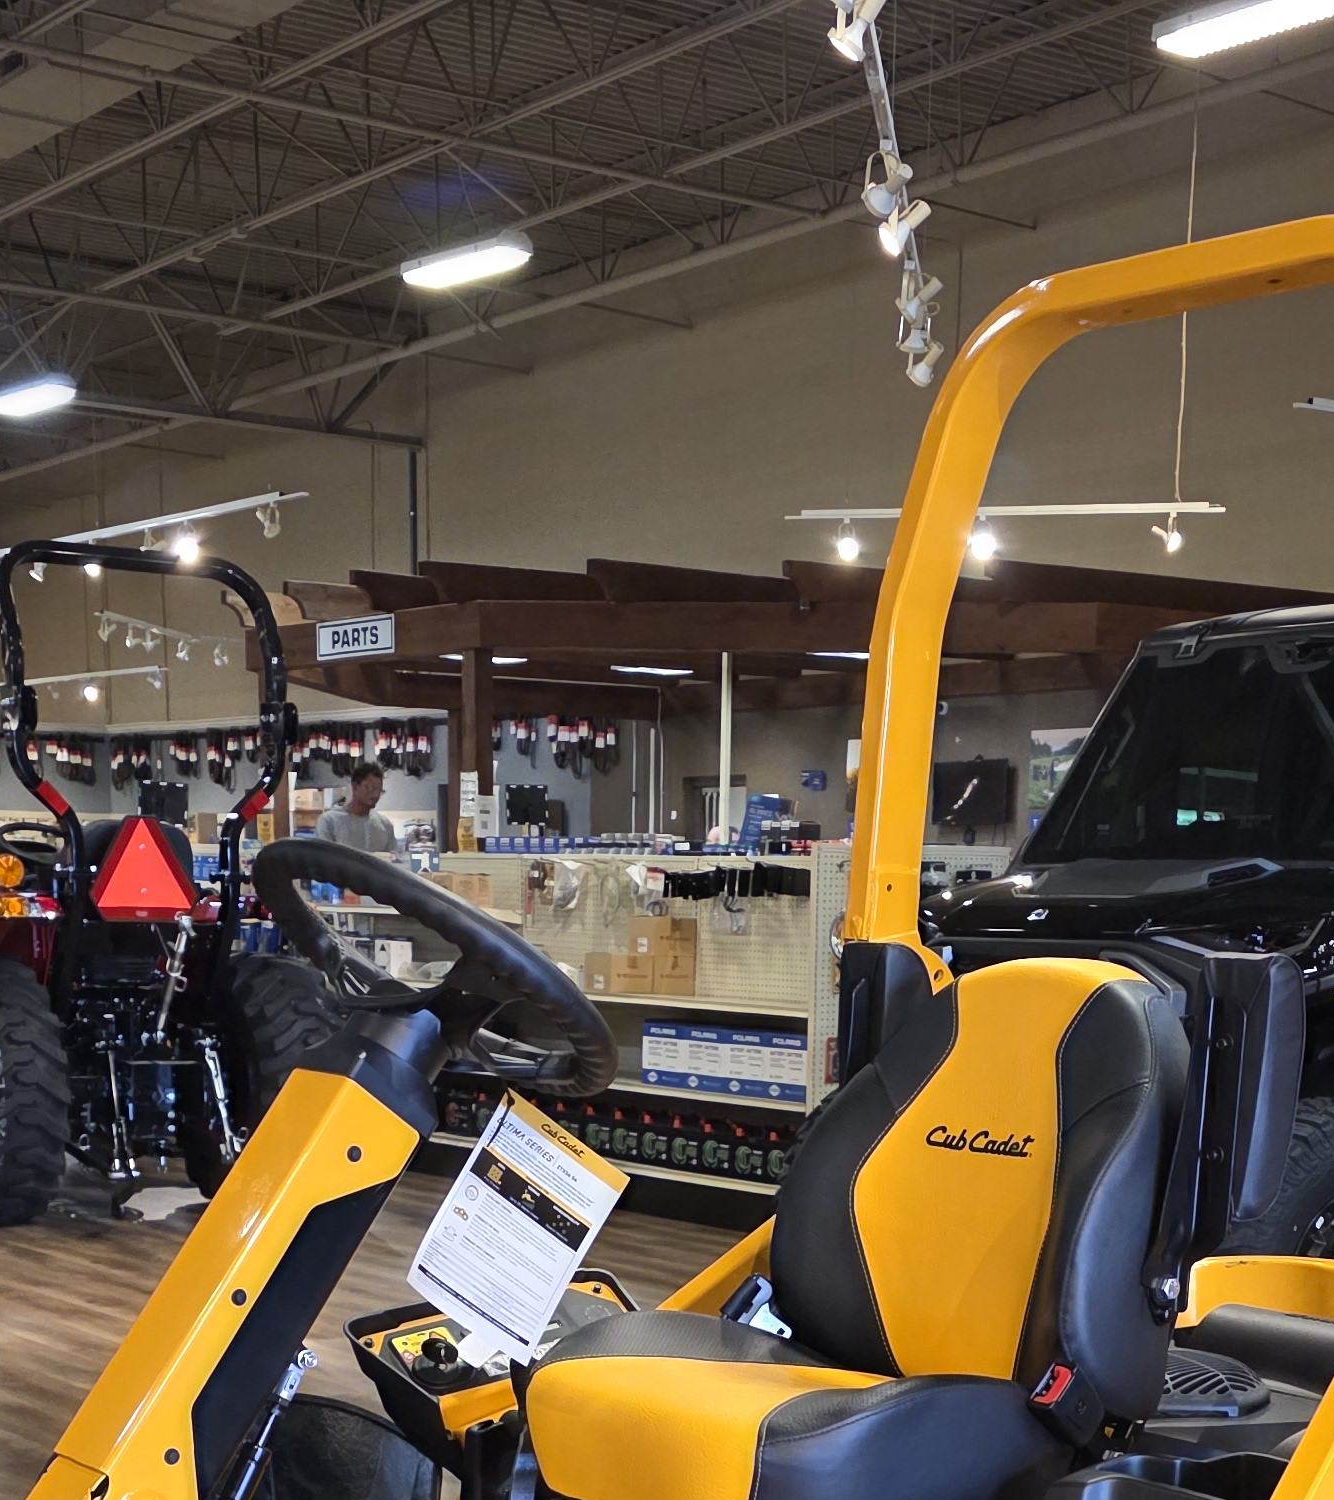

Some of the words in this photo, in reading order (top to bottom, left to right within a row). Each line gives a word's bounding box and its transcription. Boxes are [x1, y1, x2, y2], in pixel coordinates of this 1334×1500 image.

[331, 625, 379, 650] PARTS
[525, 1138, 555, 1163] SERIES
[540, 1123, 558, 1139] Cub
[556, 1136, 586, 1159] Cadet
[926, 1125, 967, 1150] Cub
[968, 1130, 1035, 1158] Cadet
